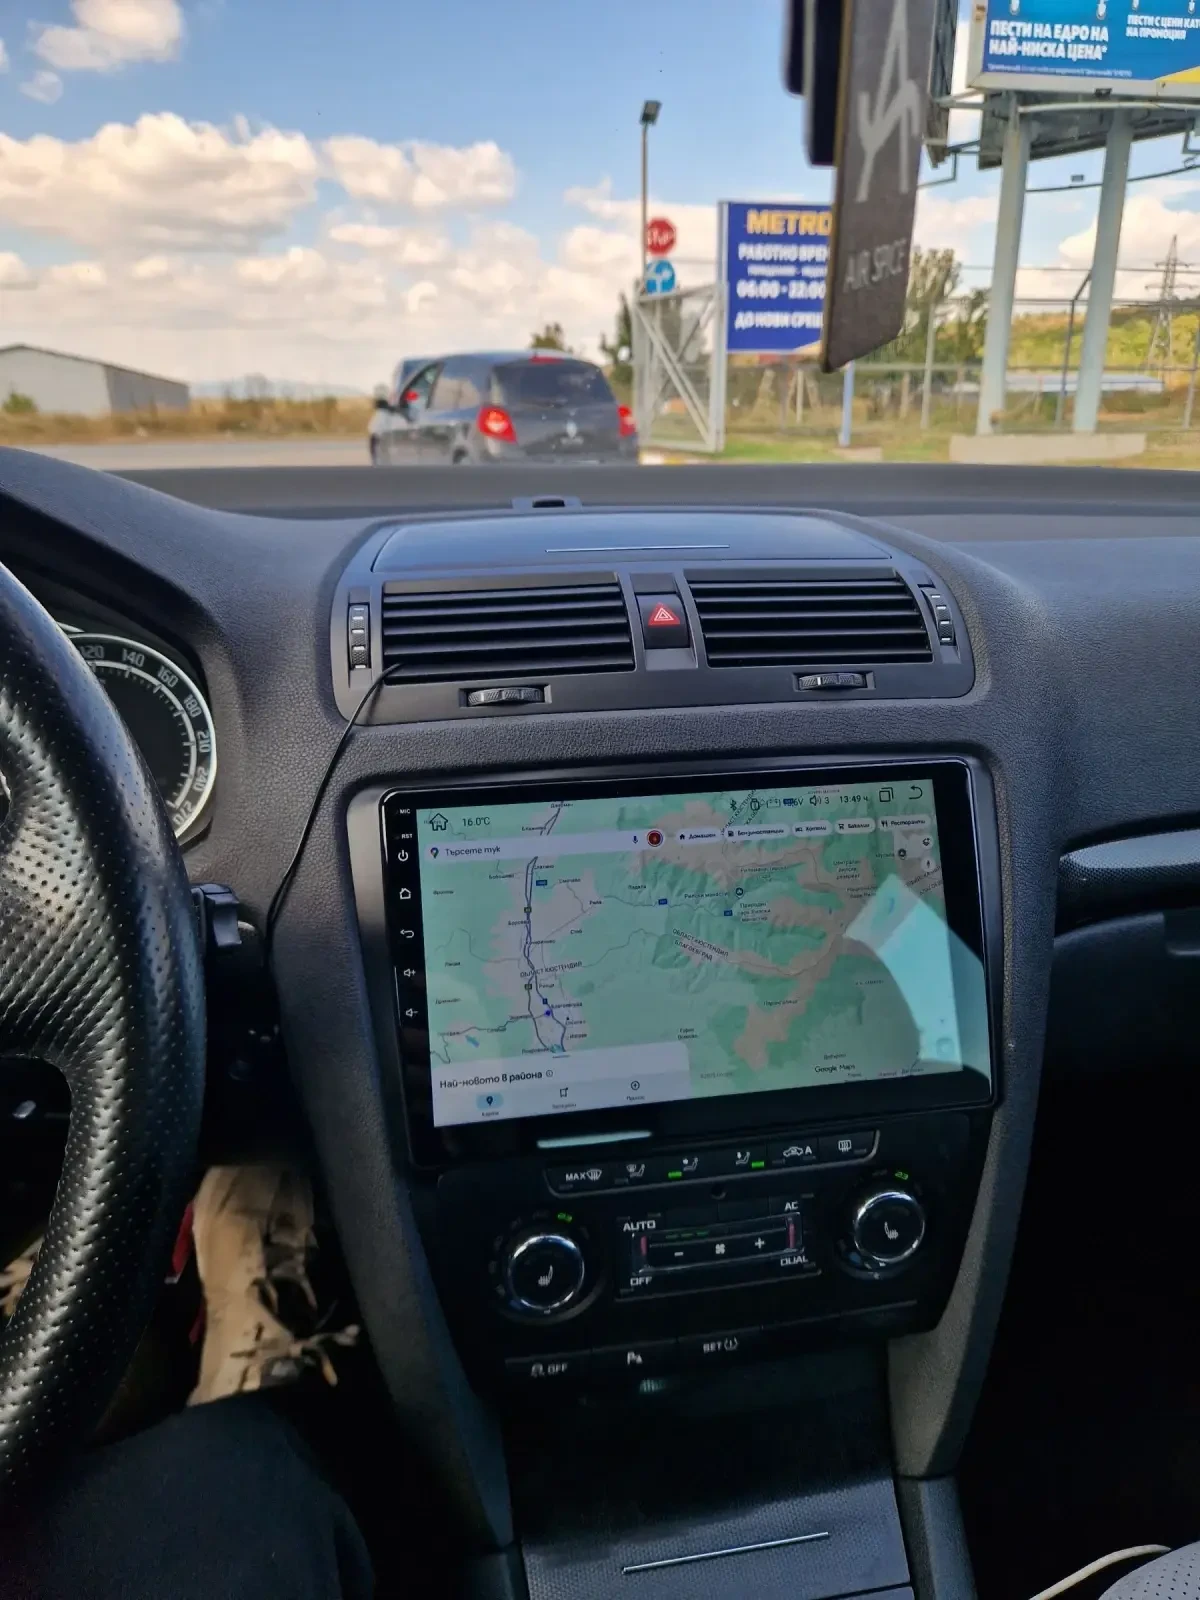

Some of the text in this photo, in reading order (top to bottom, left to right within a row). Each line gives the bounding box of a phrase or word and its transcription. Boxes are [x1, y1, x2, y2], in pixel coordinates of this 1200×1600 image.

[1127, 14, 1154, 26] ПЕСТИ
[1155, 16, 1161, 26] С
[1161, 17, 1184, 28] ЦЕНИ
[990, 19, 1109, 42] ПЕСТИ НА ЕДРО НА
[1126, 27, 1138, 37] НА
[989, 38, 1065, 58] НАЙ-НИСКА
[121, 648, 145, 668] 140
[157, 666, 179, 688] 160
[183, 694, 202, 718] 180
[197, 729, 211, 753] 210
[192, 766, 208, 792] 240
[839, 795, 861, 803] 13:49
[172, 800, 193, 825] 270
[462, 817, 491, 827] 16.0°C
[446, 846, 501, 857] Търсете тук
[672, 928, 694, 941] ОБЛАСТ
[814, 1064, 839, 1074] Google
[839, 1062, 856, 1073] Maps
[439, 1070, 543, 1089] Най-новото в района
[805, 1145, 813, 1154] A
[565, 1172, 586, 1182] MAX
[784, 1201, 799, 1211] AC
[623, 1220, 656, 1232] AUTO
[780, 1256, 809, 1267] DUAL
[630, 1276, 652, 1287] OFF
[547, 1363, 568, 1374] OFF
